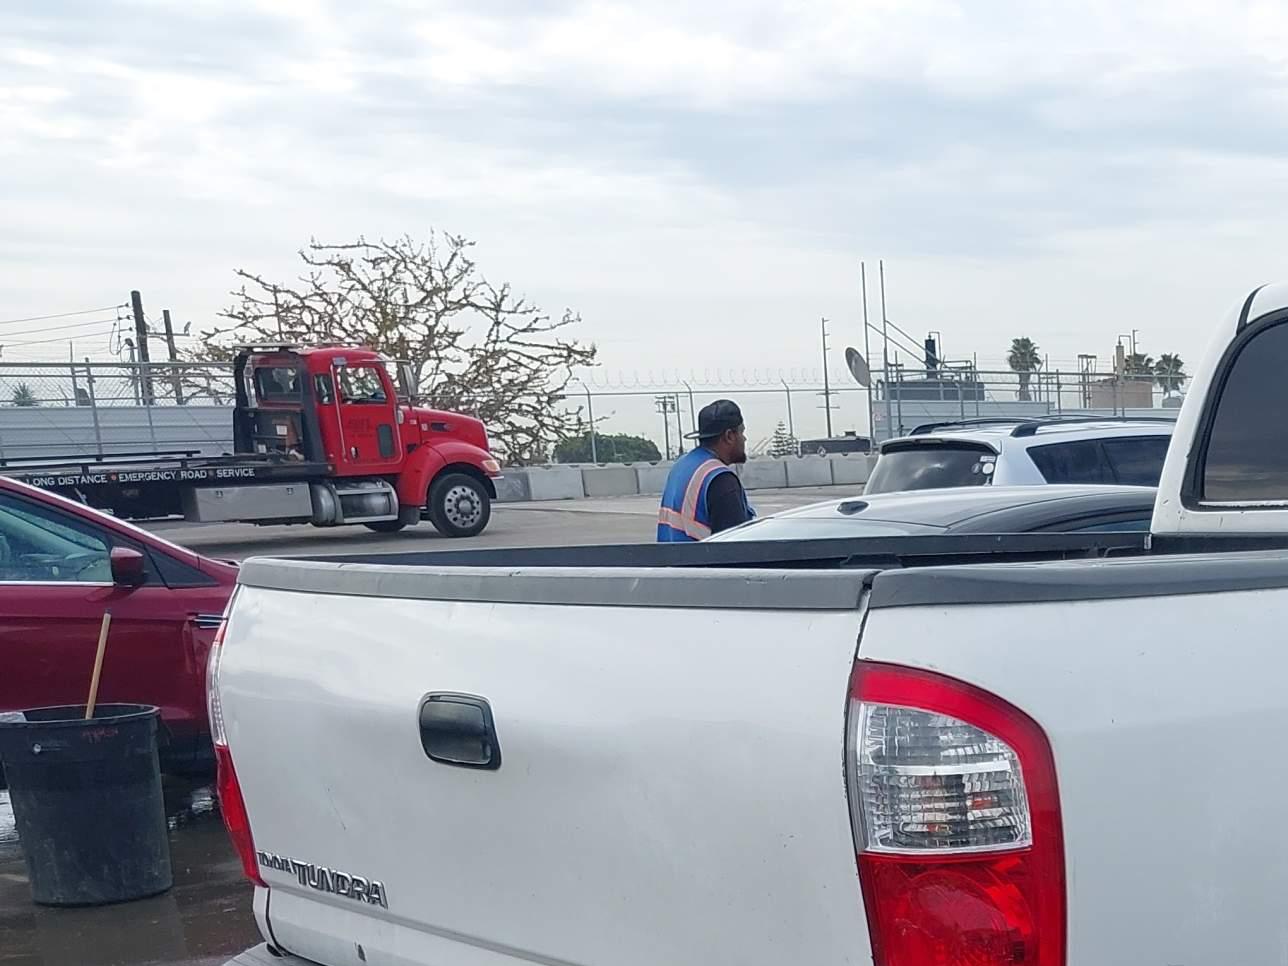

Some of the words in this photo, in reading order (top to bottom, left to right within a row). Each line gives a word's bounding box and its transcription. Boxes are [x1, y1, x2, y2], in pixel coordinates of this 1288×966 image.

[26, 476, 55, 487] LONG
[57, 473, 108, 486] DISTANCE
[118, 470, 177, 482] EMERGENCY
[180, 469, 207, 480] ROAD
[216, 467, 255, 479] SERVICE
[292, 859, 388, 909] TUNDRA
